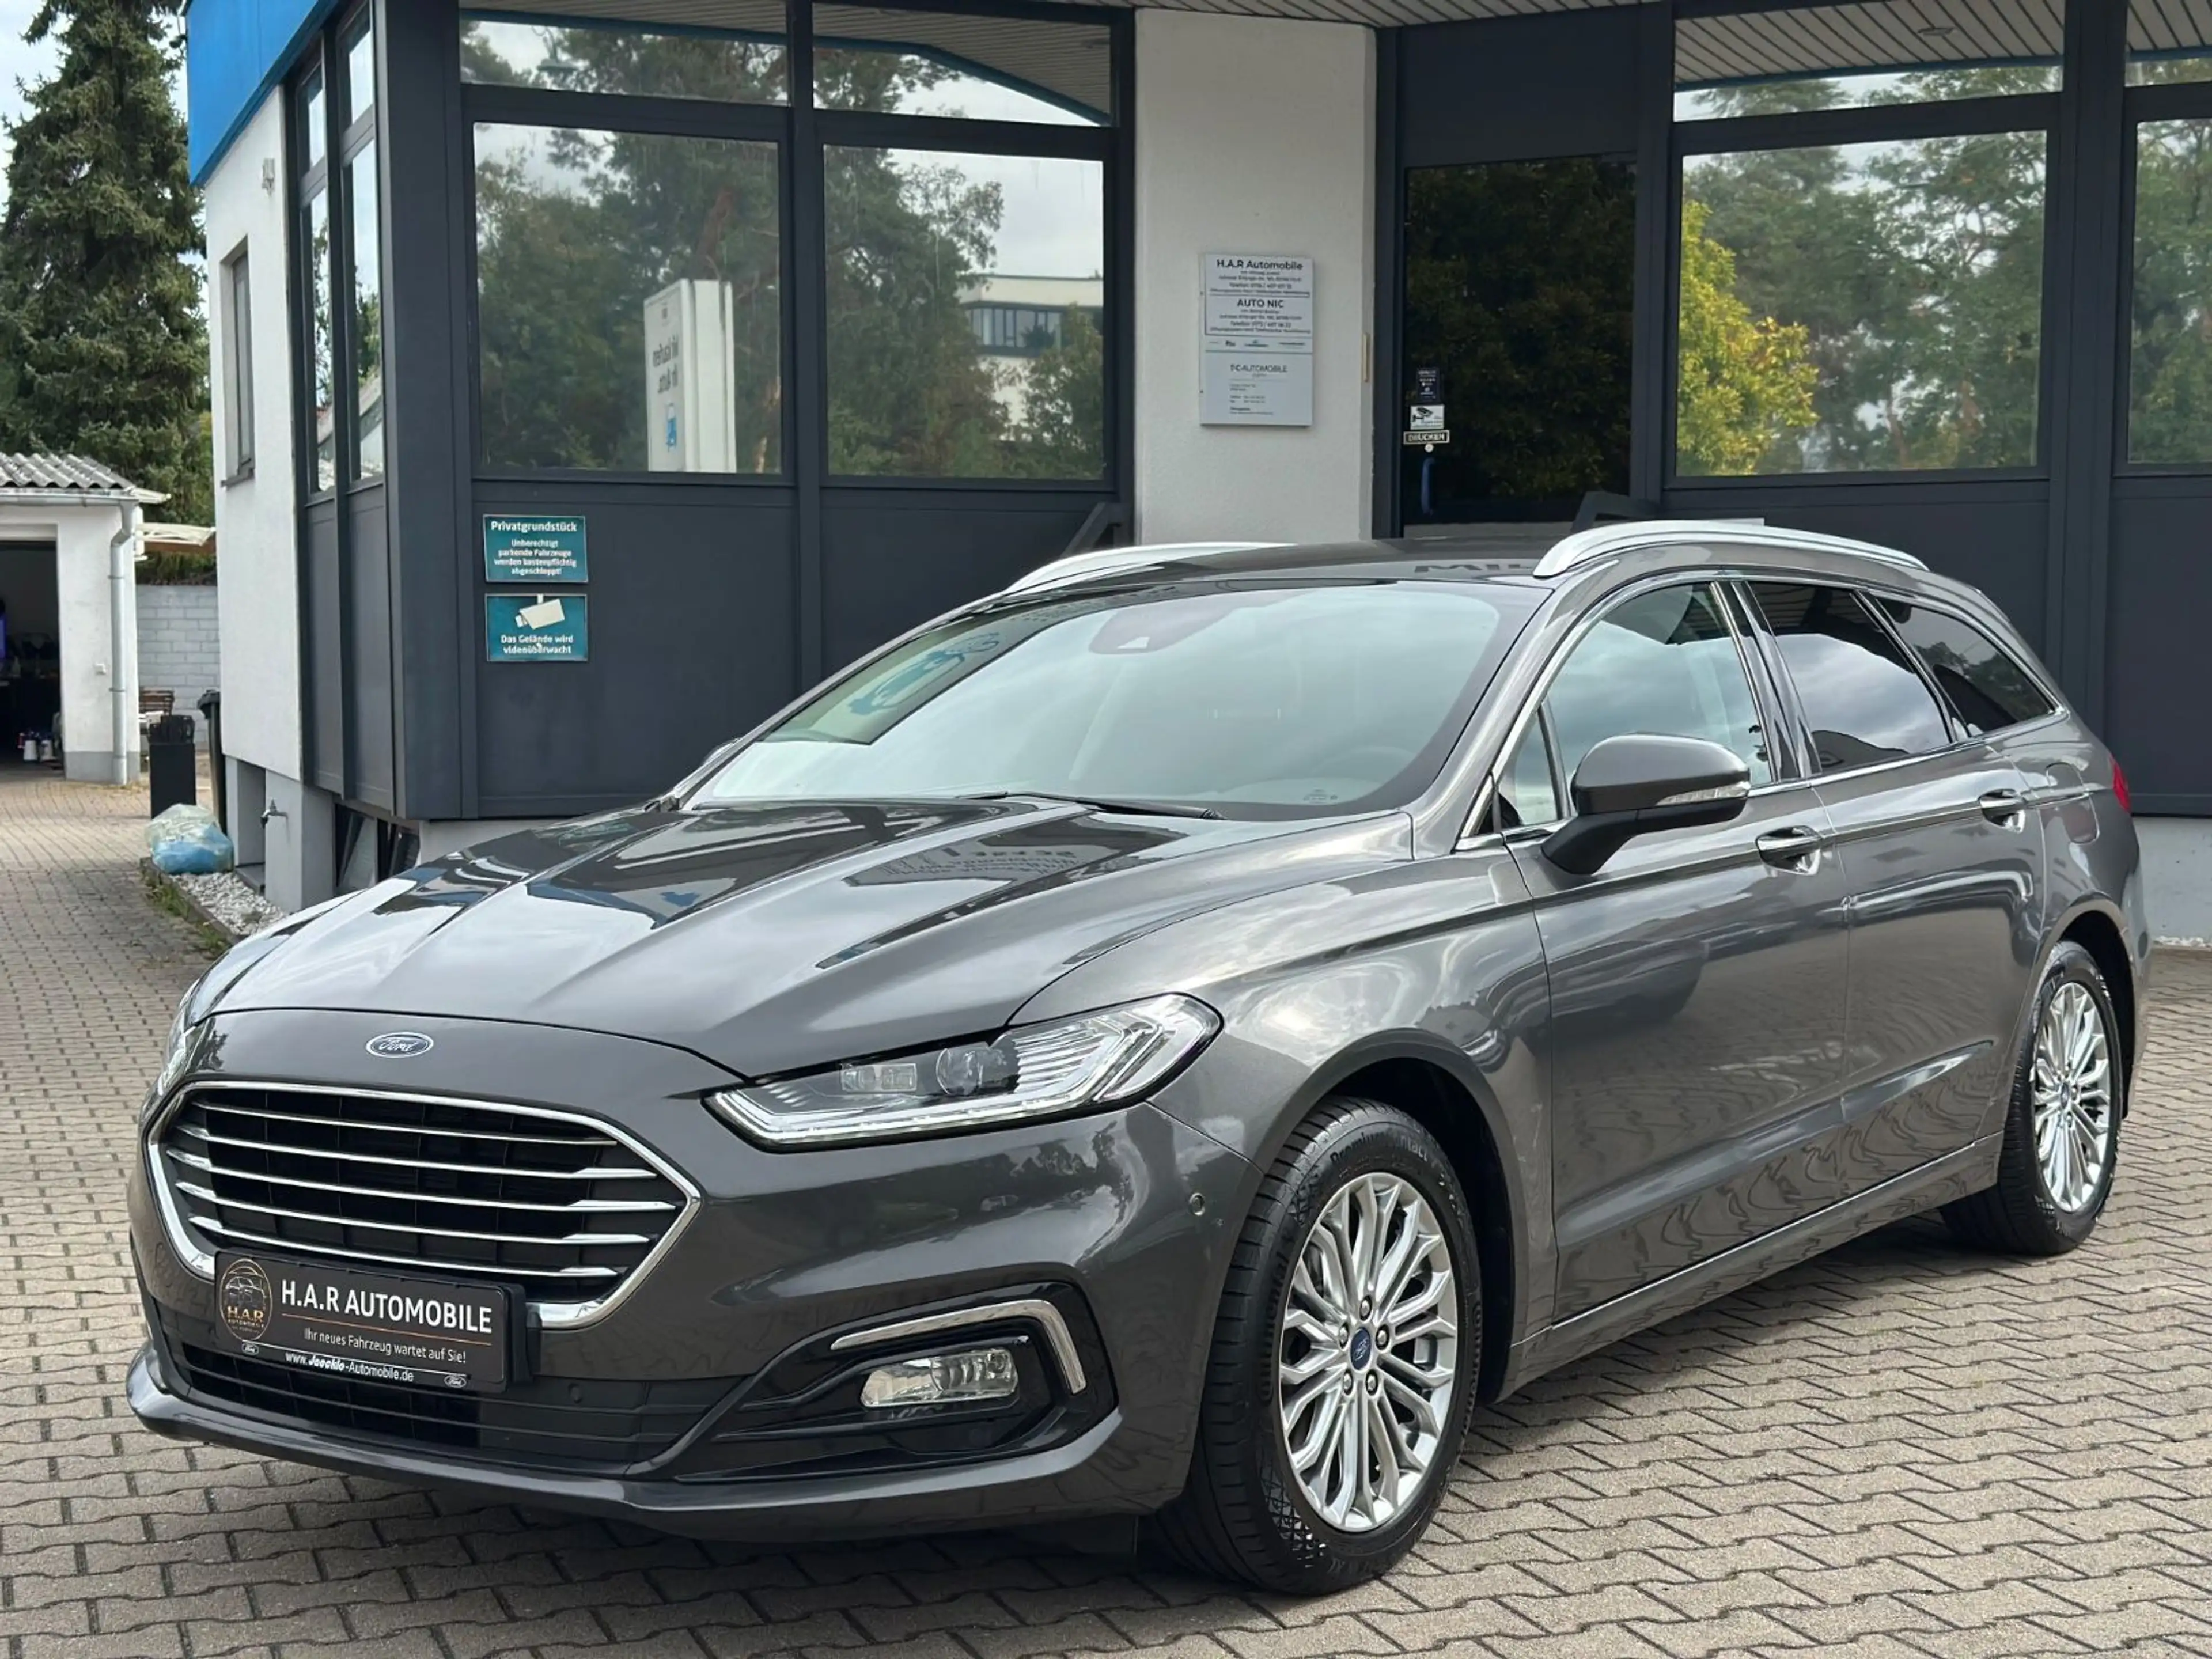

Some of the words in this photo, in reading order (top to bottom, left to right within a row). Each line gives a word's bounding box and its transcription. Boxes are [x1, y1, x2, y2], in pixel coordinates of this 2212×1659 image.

[1217, 259, 1244, 268] H.A.R
[1247, 260, 1303, 270] Automobile
[1237, 299, 1264, 308] AUTO
[1267, 300, 1284, 308] NIC
[491, 521, 577, 533] Privatgrundstück
[511, 539, 559, 548] Unberechtigt
[498, 548, 533, 558] parkende
[534, 548, 572, 558] Fahrzeuge
[493, 558, 522, 566] werden
[523, 558, 577, 568] kostenpflichtig
[501, 634, 517, 643] Das
[518, 634, 552, 643] Gelände
[555, 634, 574, 643] wird
[282, 1279, 340, 1313] H.A.R
[345, 1289, 493, 1333] AUTOMOBILE
[227, 1306, 264, 1323] H.A.R
[304, 1328, 316, 1342] Ihr
[319, 1332, 346, 1346] neues
[348, 1335, 392, 1355] Fahrzeug
[393, 1346, 426, 1358] wartet
[429, 1347, 445, 1360] auf
[448, 1349, 466, 1363] Sie!
